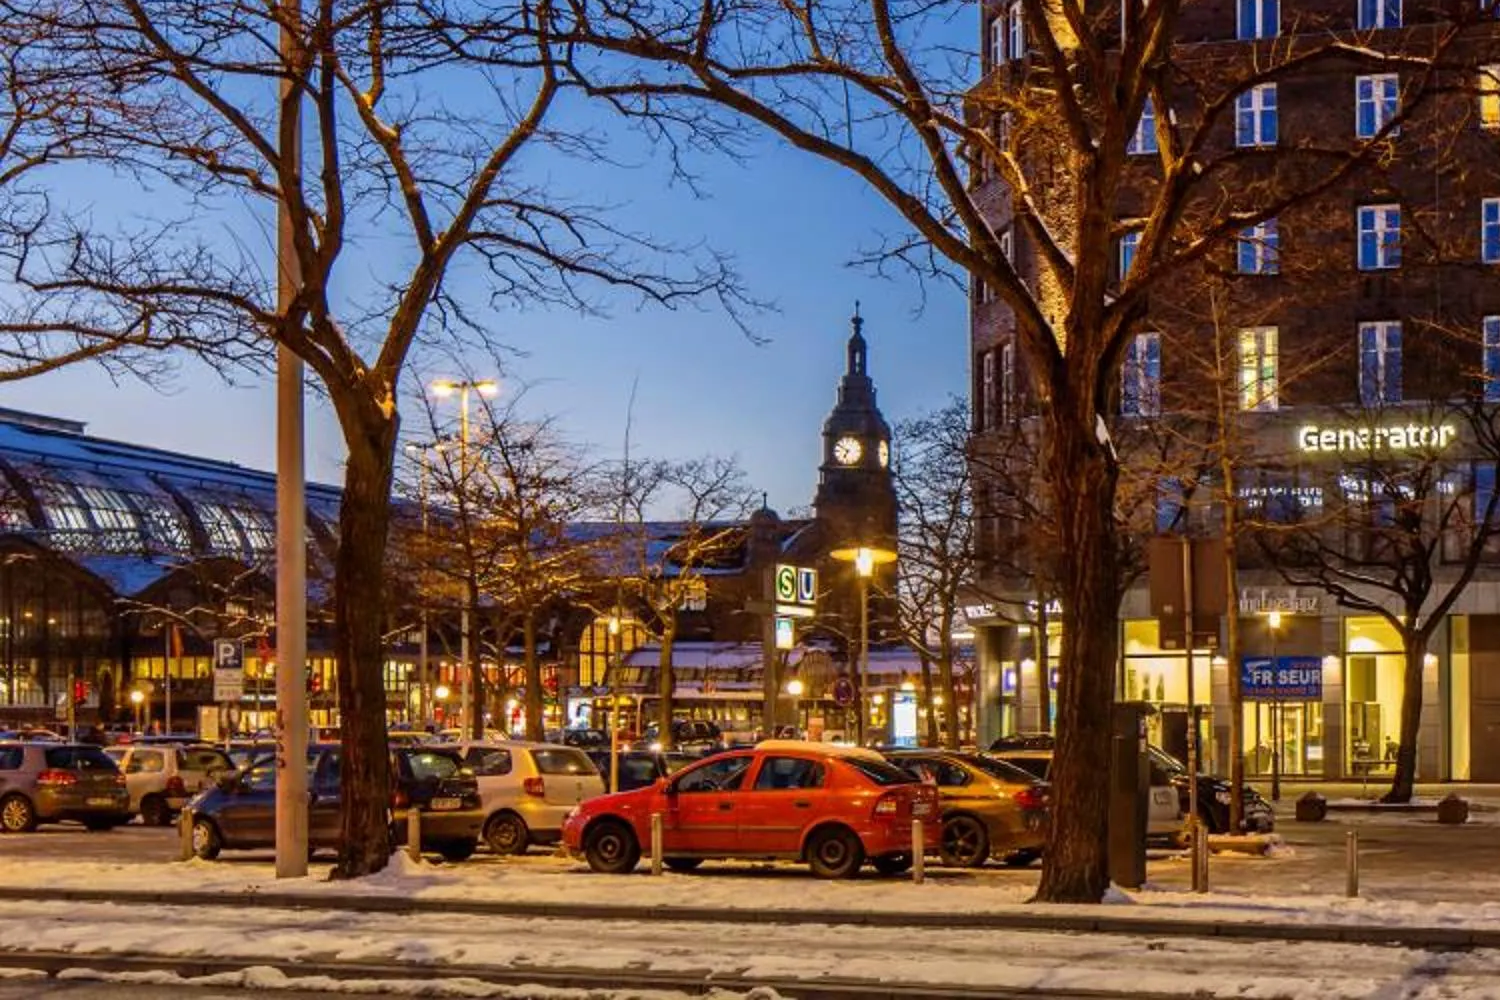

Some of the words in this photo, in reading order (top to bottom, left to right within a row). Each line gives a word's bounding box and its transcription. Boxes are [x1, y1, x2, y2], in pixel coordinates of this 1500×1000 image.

[1299, 423, 1456, 451] Generator
[781, 570, 794, 597] S
[801, 571, 816, 600] U
[219, 643, 236, 665] P
[1252, 669, 1321, 685] FRSEUR
